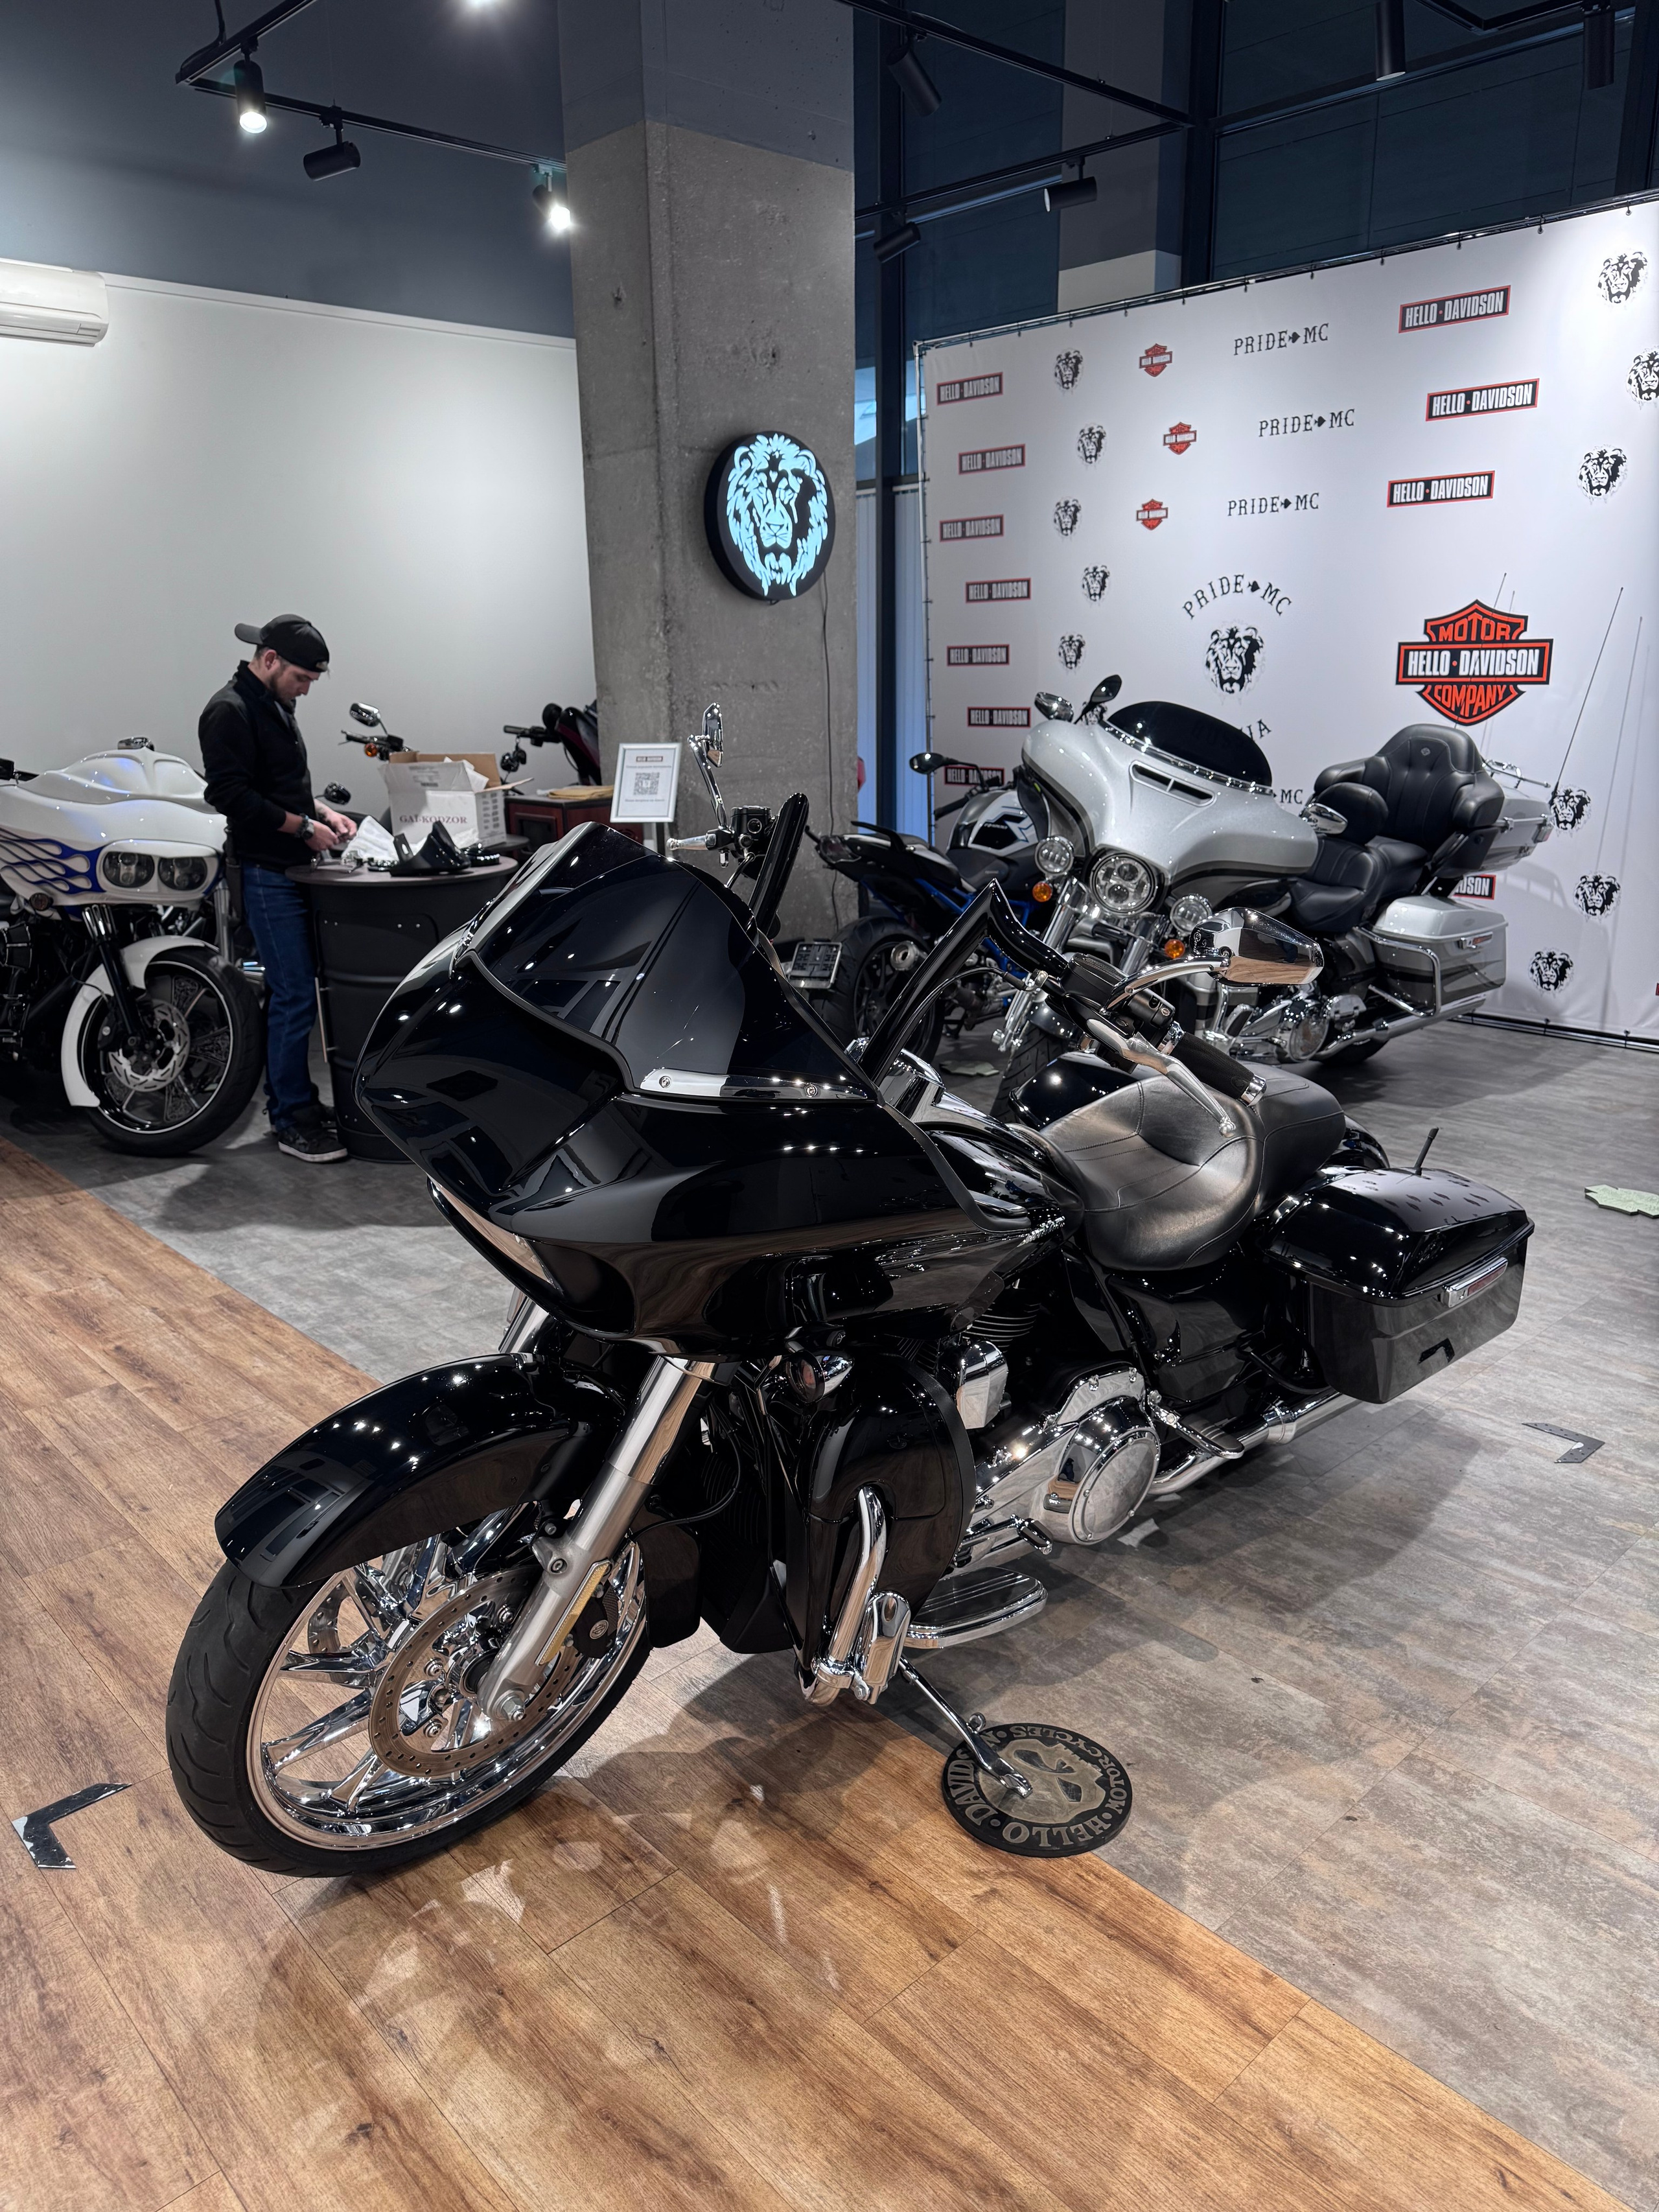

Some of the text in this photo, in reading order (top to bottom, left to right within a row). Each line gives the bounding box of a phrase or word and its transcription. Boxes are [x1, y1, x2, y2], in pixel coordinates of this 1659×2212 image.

[1405, 291, 1504, 327] HELLO DAVIDSON
[1233, 323, 1328, 356] PRIDE MC
[940, 376, 999, 402] HELLO DAVIDSON
[1432, 384, 1533, 416] HELLO DAVIDSON
[1259, 408, 1354, 437] PRIDE MC
[962, 447, 1022, 471] HELLO DAVIDSON
[1393, 475, 1489, 503] HELLO DAVIDSON
[1227, 493, 1319, 517] PRIDE MC
[942, 518, 1001, 539] HELLO DAVIDSON
[968, 581, 1028, 600] HELLO DAVIDSON
[1182, 574, 1292, 620] PRIDE MC
[1439, 612, 1511, 642] MOTOR
[1408, 649, 1540, 676] HELLO DAVIDSON
[1433, 684, 1507, 717] COMPANY
[1279, 789, 1303, 804] MC
[1009, 1725, 1127, 1815] MOTORCYCLES
[1002, 1815, 1111, 1847] HELLO
